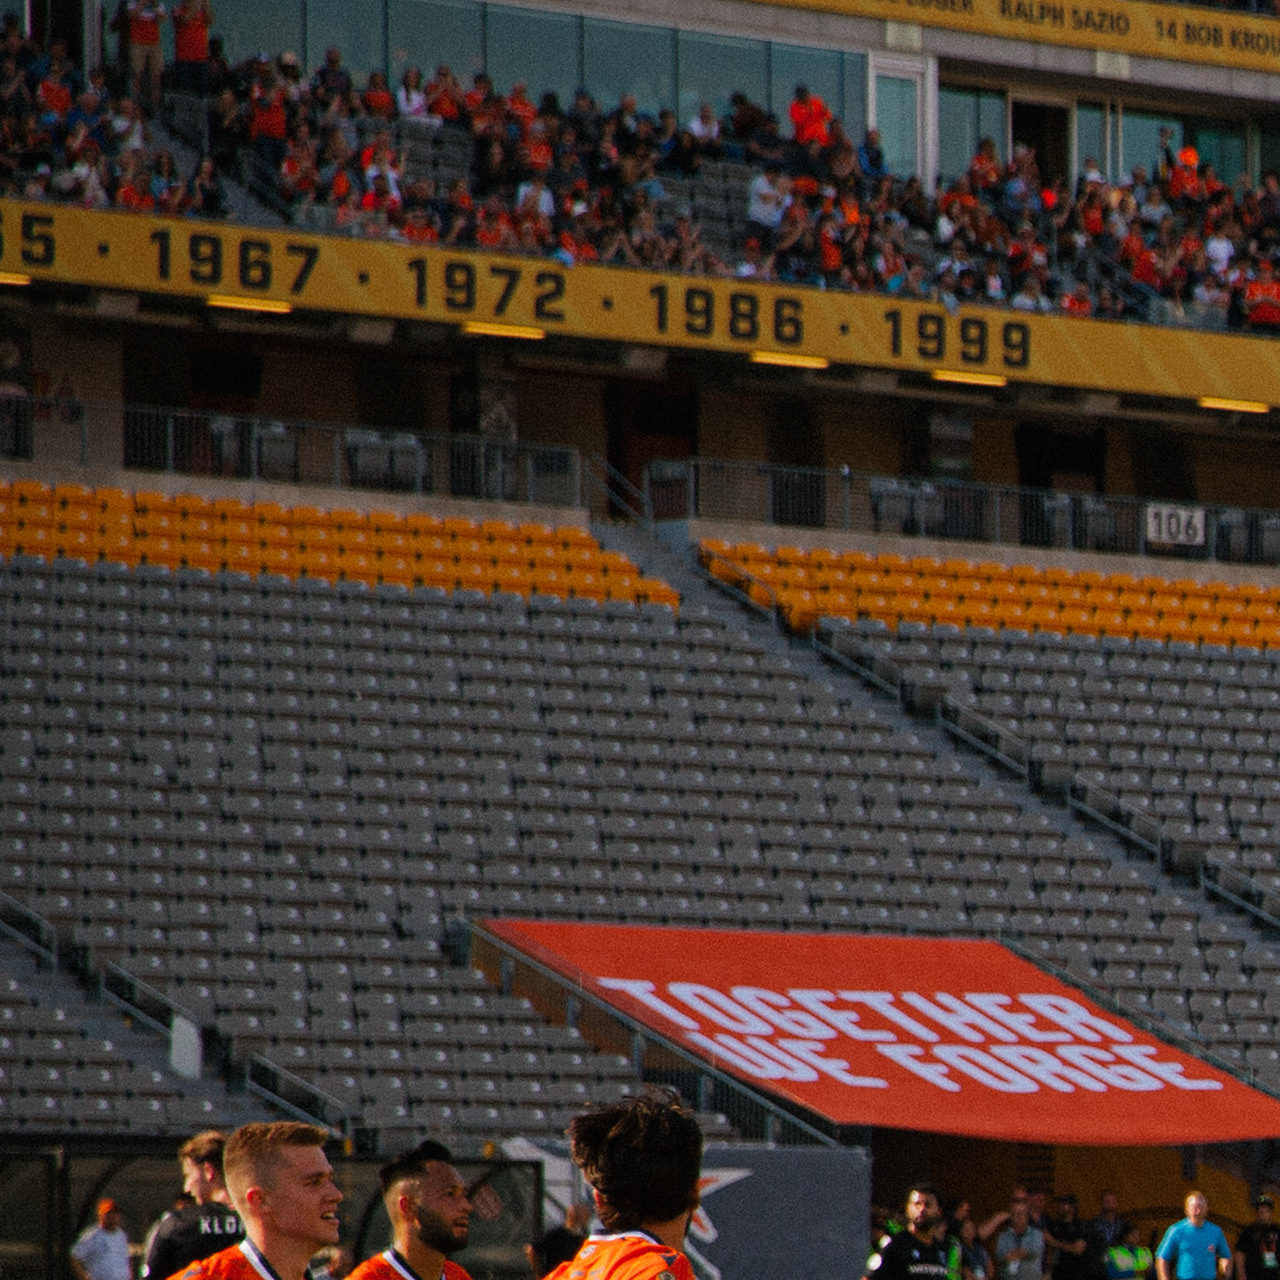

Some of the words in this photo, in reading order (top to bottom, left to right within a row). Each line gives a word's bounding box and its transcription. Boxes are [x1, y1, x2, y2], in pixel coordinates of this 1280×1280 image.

[1001, 0, 1065, 27] RALPH
[1072, 7, 1130, 36] SAZIO
[1155, 18, 1178, 42] 14
[1184, 20, 1223, 48] BOB
[150, 229, 321, 296] 1967
[407, 256, 567, 323] 1972
[649, 282, 806, 345] 1986
[884, 308, 1032, 369] 1999
[1153, 511, 1199, 543] 106
[595, 975, 1134, 1044] TOGETHER
[686, 1031, 888, 1088] WE
[877, 1043, 1224, 1092] FORGE
